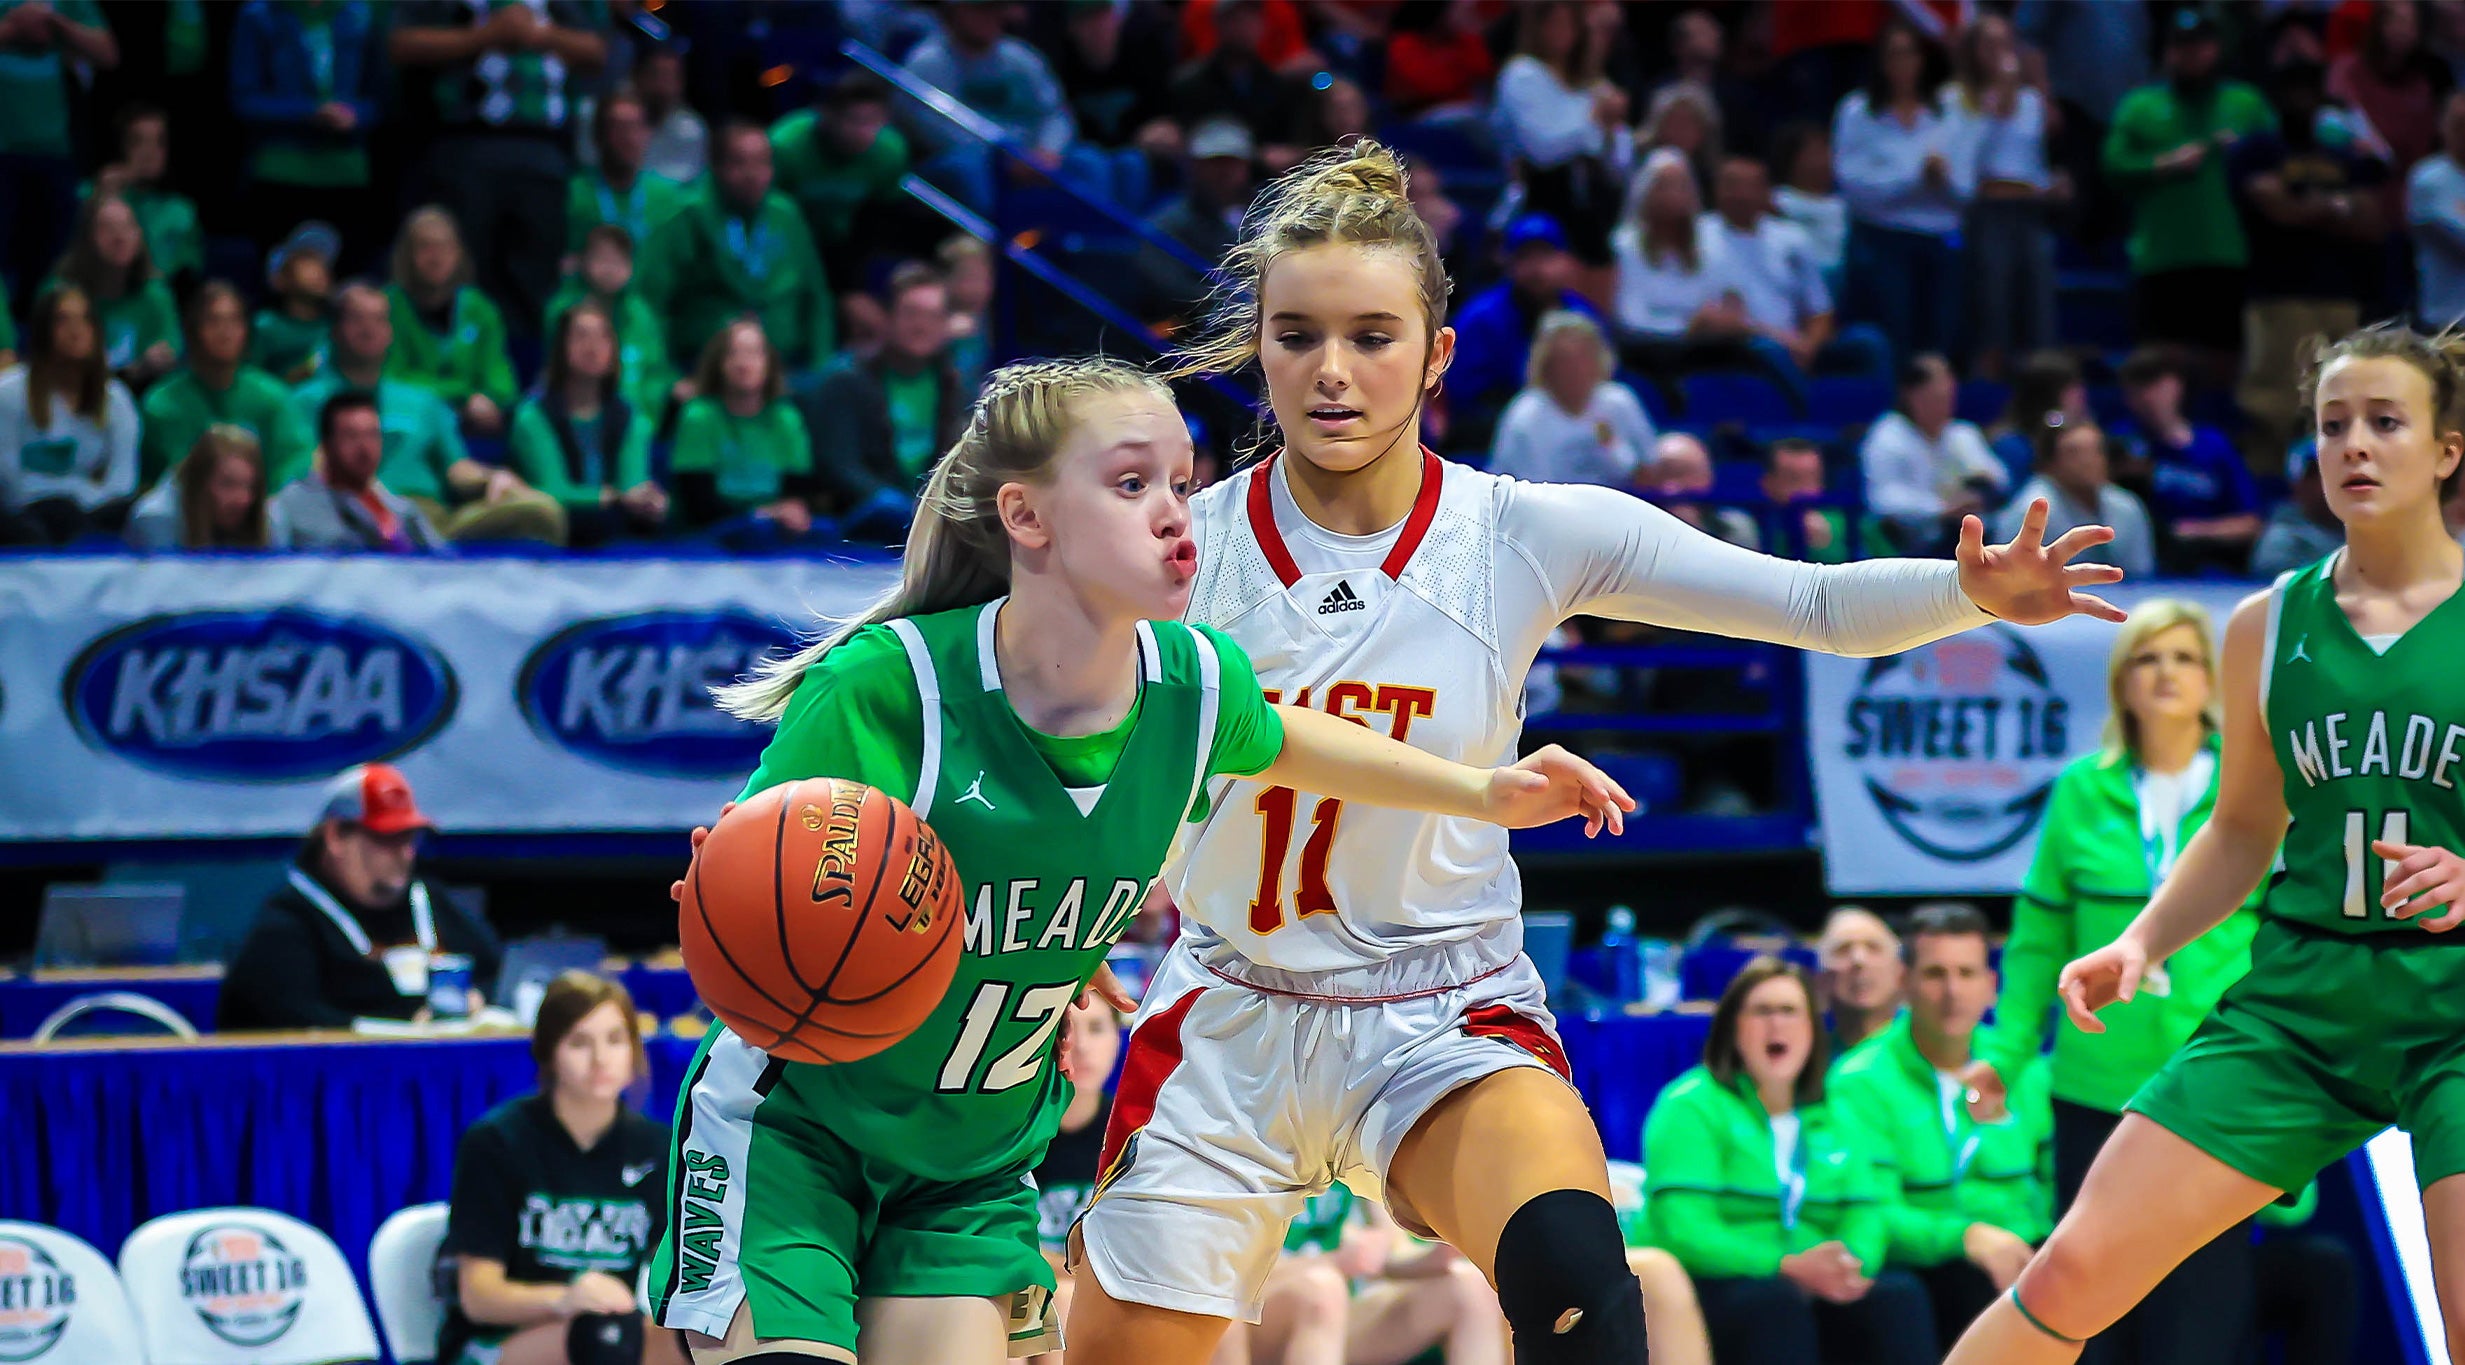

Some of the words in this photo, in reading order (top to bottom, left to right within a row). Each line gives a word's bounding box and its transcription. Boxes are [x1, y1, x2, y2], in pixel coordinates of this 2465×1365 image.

[1317, 600, 1366, 615] adidas
[110, 645, 401, 743] KHSAA
[562, 645, 768, 743] KHS
[1262, 680, 1437, 743] ST
[1844, 695, 2001, 760] SWEET
[2018, 695, 2069, 759] 16
[2289, 709, 2465, 789] MEADE
[884, 815, 936, 932] LEGAC
[1247, 784, 1344, 937] 11
[934, 975, 1082, 1095] 12
[679, 1149, 731, 1294] WAVES
[179, 1262, 266, 1298] SWEET
